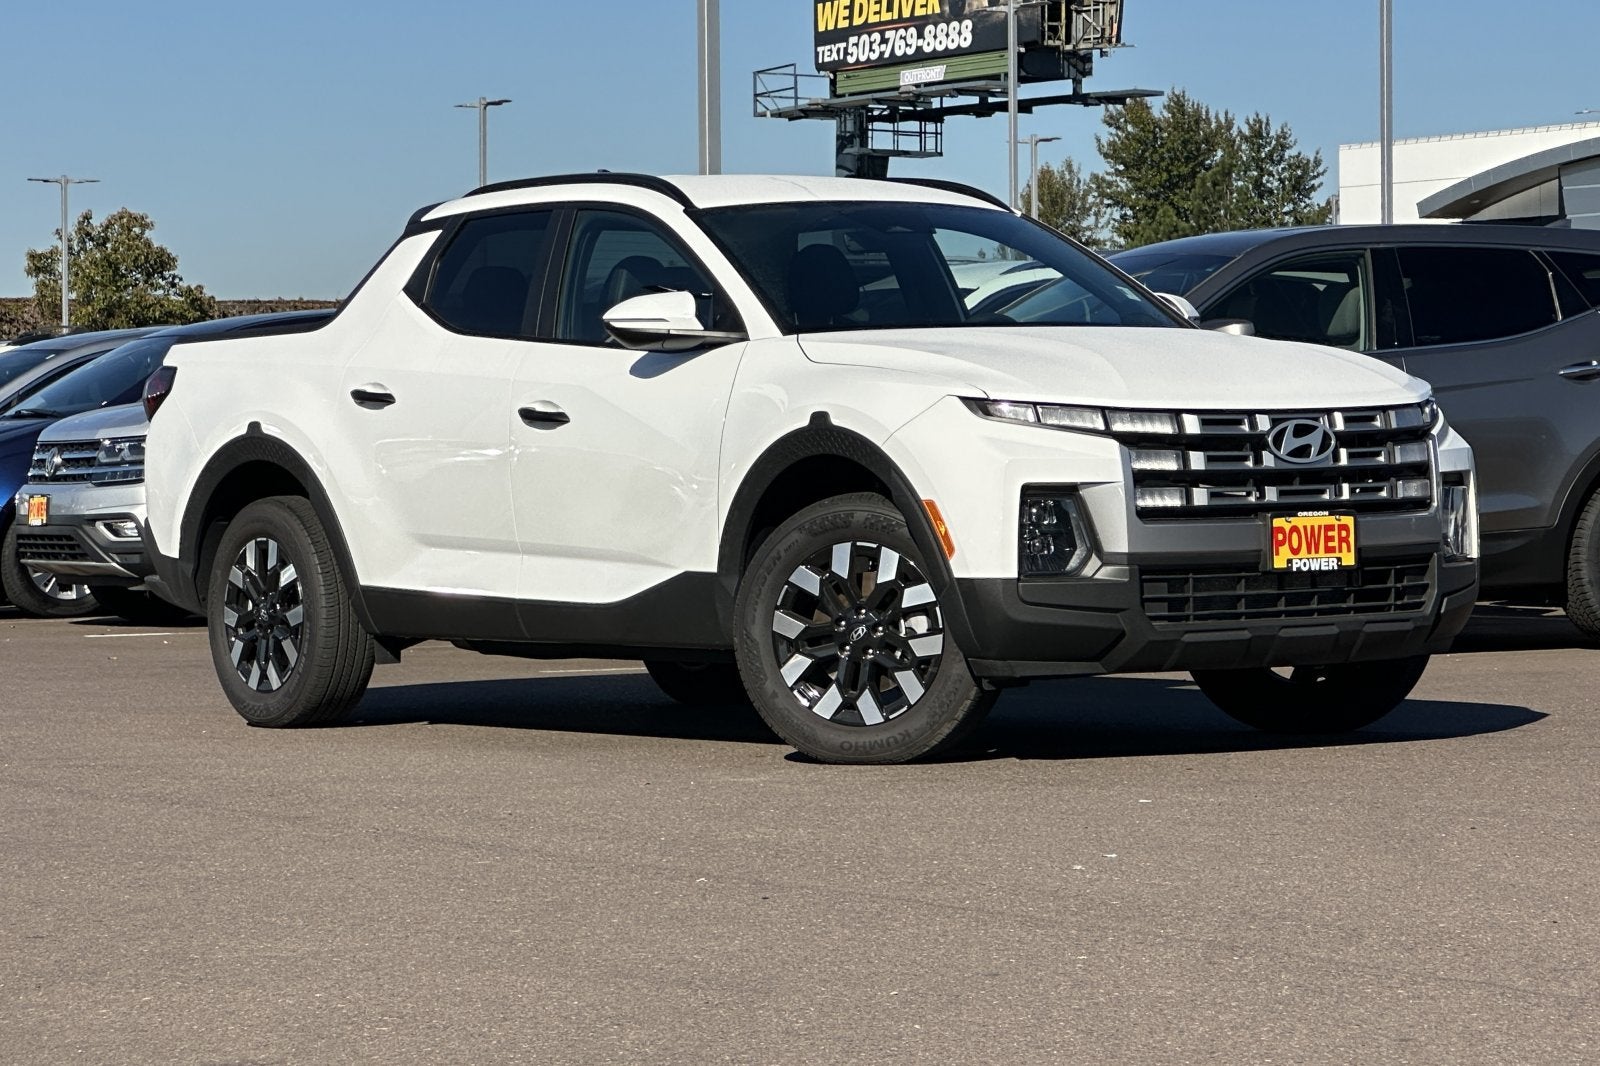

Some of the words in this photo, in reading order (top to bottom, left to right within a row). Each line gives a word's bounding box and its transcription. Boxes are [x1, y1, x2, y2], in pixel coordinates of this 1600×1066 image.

[817, 0, 849, 32] WE
[817, 42, 847, 63] TEXT
[847, 19, 973, 64] 503-769-8888
[904, 67, 943, 82] OUTFRONT
[1273, 523, 1352, 556] POWER
[1292, 557, 1338, 571] POWER
[839, 729, 912, 752] KUMHO
